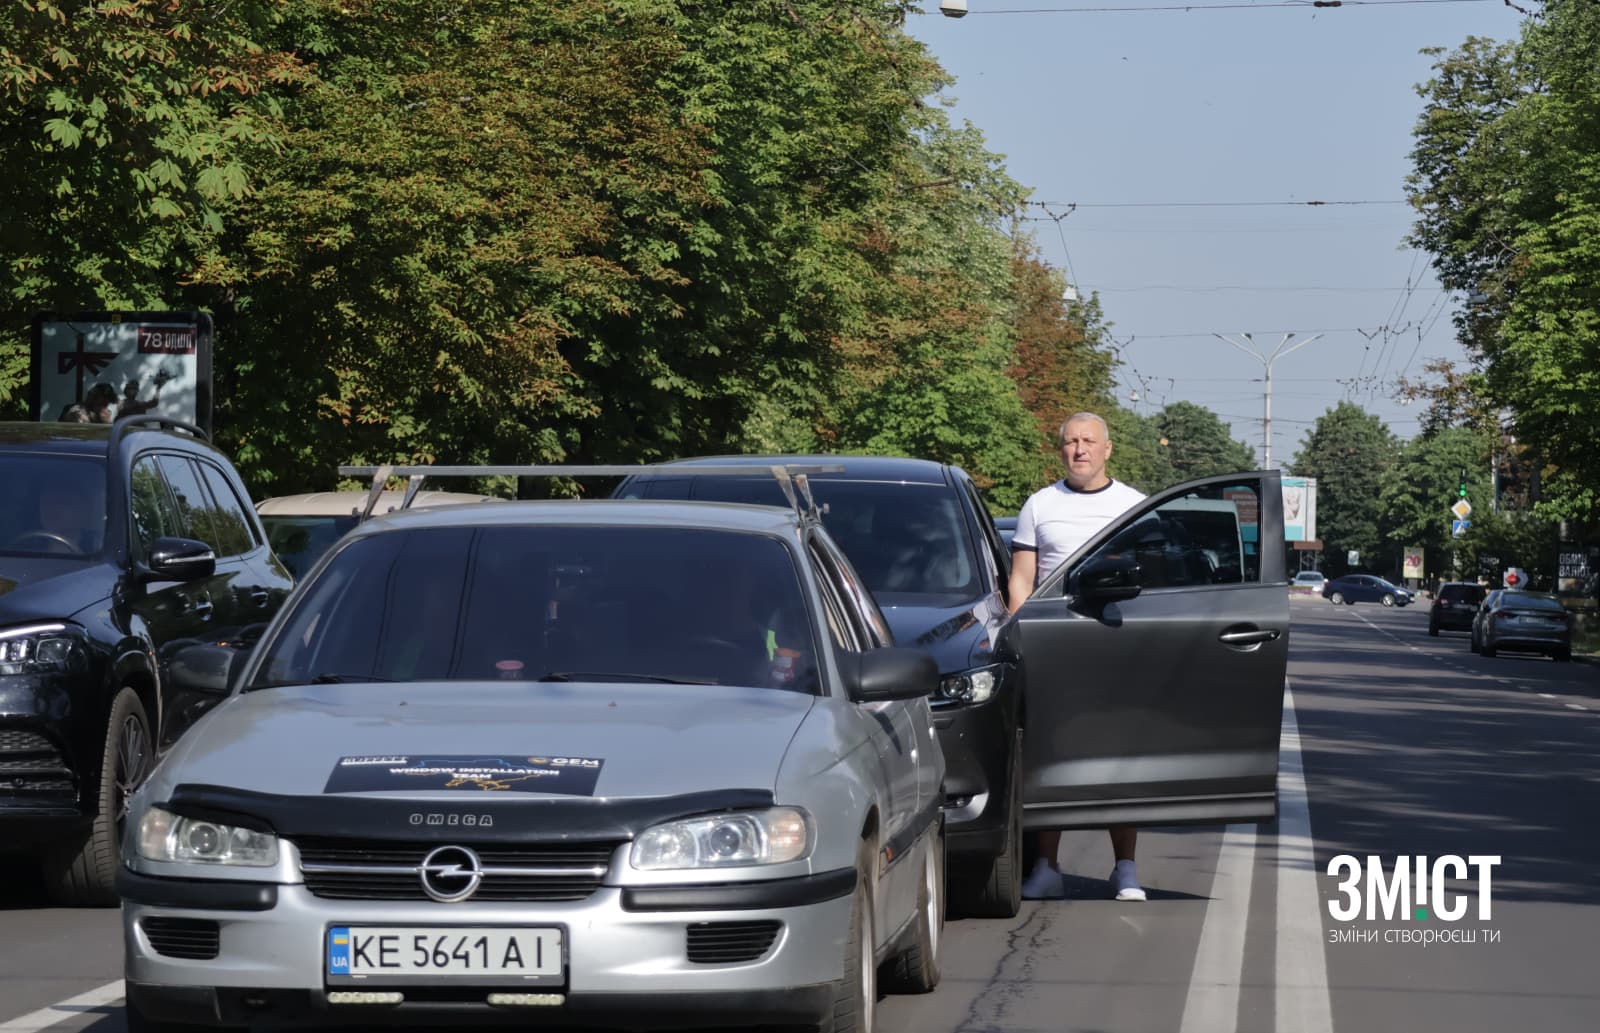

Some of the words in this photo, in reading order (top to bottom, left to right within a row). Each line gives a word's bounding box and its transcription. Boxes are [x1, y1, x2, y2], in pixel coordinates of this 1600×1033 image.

[143, 332, 163, 348] 78
[552, 757, 599, 765] GEM
[390, 767, 456, 775] WINDOW
[458, 767, 560, 776] INSTALLATION
[409, 813, 494, 827] OMEGA
[352, 935, 401, 969] KE
[412, 935, 489, 969] 5641
[332, 957, 348, 968] UA
